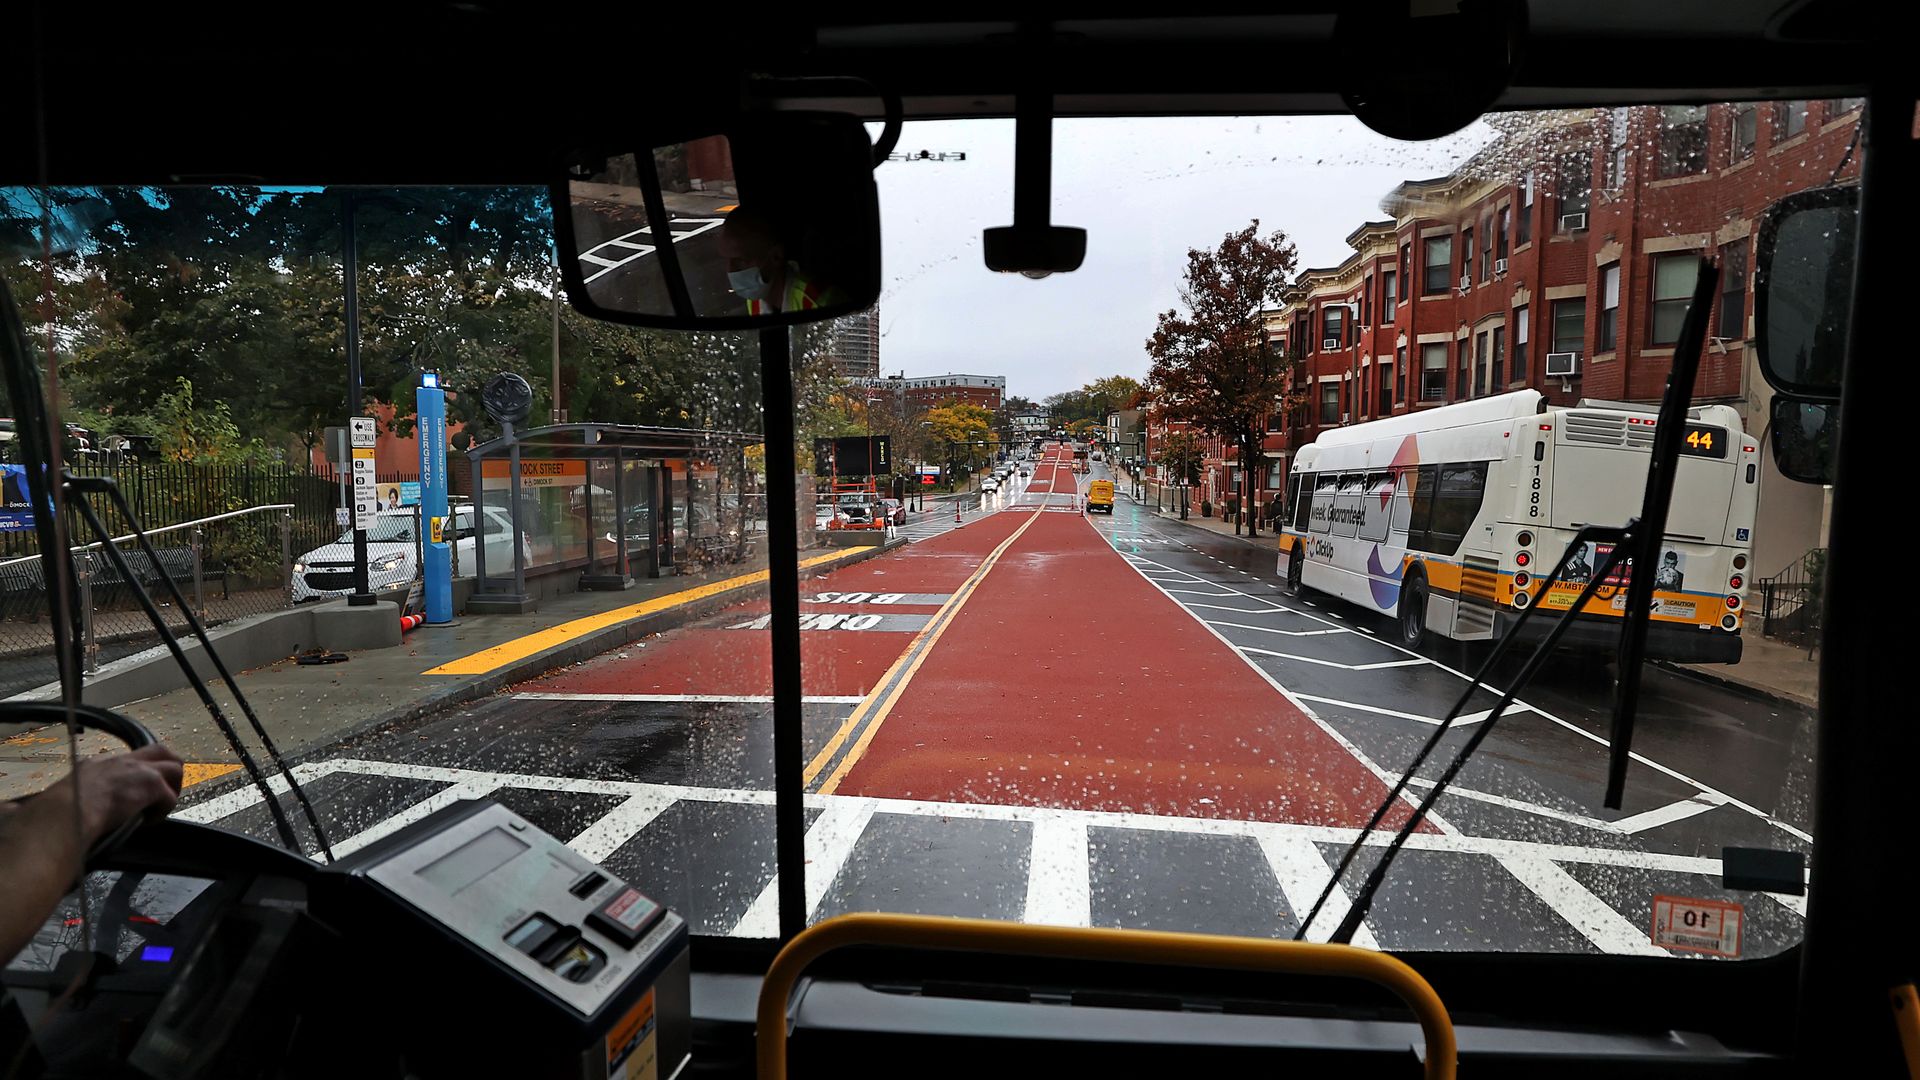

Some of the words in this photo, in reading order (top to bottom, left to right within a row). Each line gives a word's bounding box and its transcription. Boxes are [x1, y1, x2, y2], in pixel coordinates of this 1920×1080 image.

[364, 423, 373, 431] USE
[1687, 430, 1713, 450] 44
[422, 417, 431, 488] EMERGENCY
[437, 418, 445, 488] EMERGENCY
[539, 463, 564, 475] STREET
[1529, 464, 1541, 518] 1888
[1316, 540, 1334, 562] ClickUp
[803, 592, 906, 604] BUS
[1670, 600, 1696, 608] CAUTION
